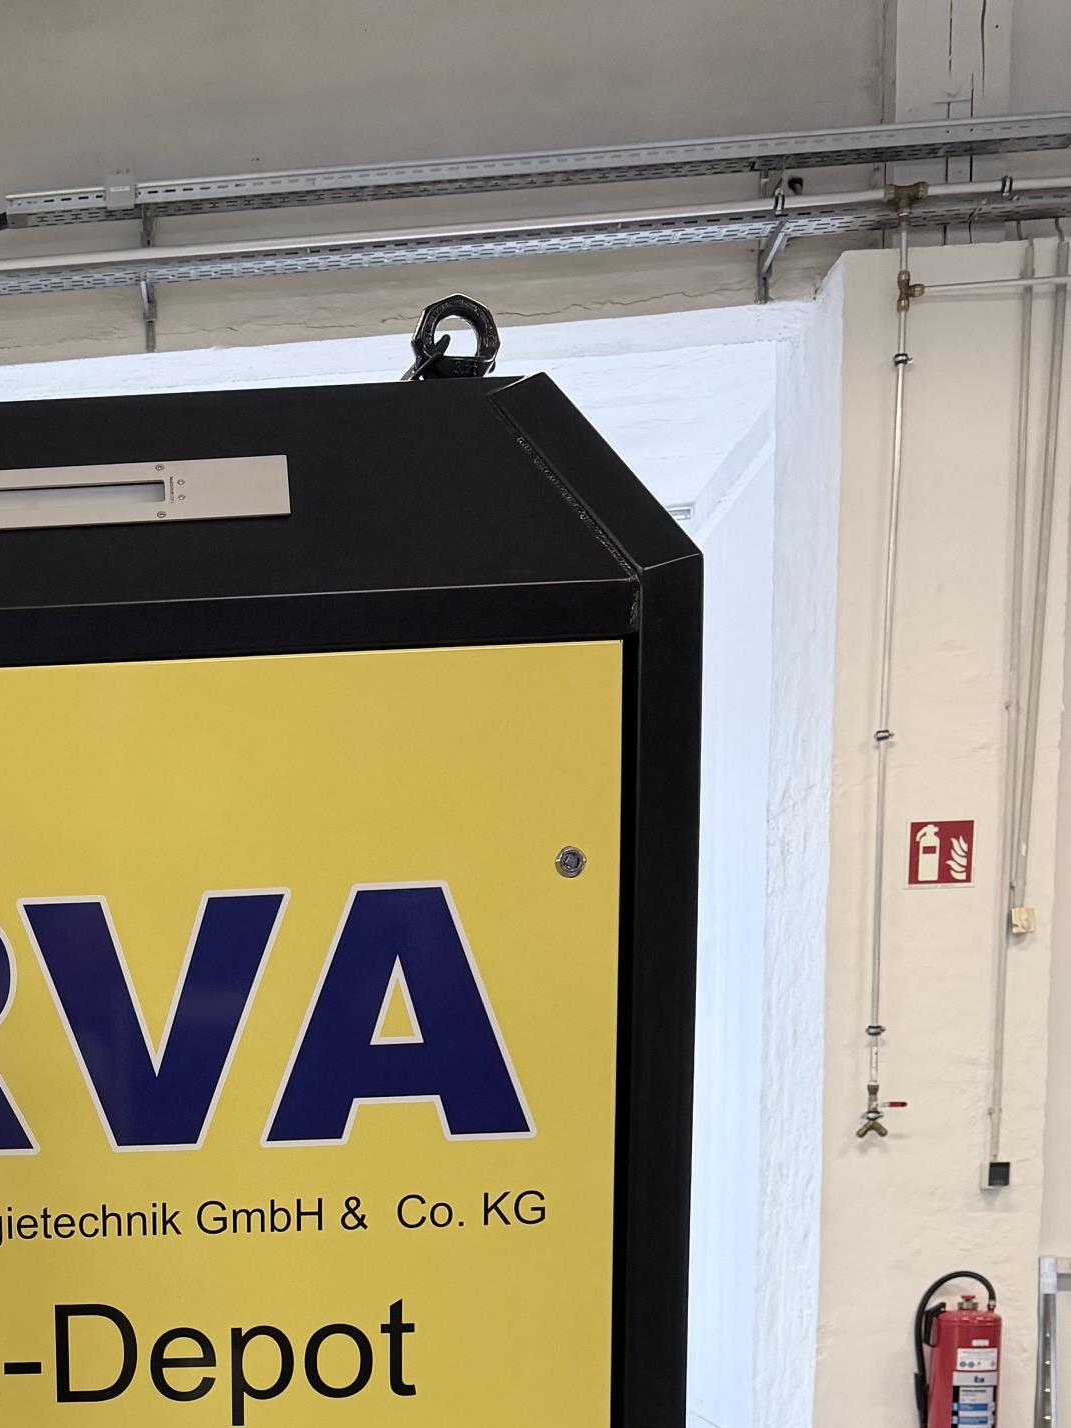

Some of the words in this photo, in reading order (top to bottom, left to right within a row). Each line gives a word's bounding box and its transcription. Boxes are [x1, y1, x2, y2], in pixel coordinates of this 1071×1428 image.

[196, 1197, 323, 1235] GmbH
[340, 1196, 369, 1231] &
[397, 1194, 464, 1229] Co.
[483, 1190, 547, 1226] KG
